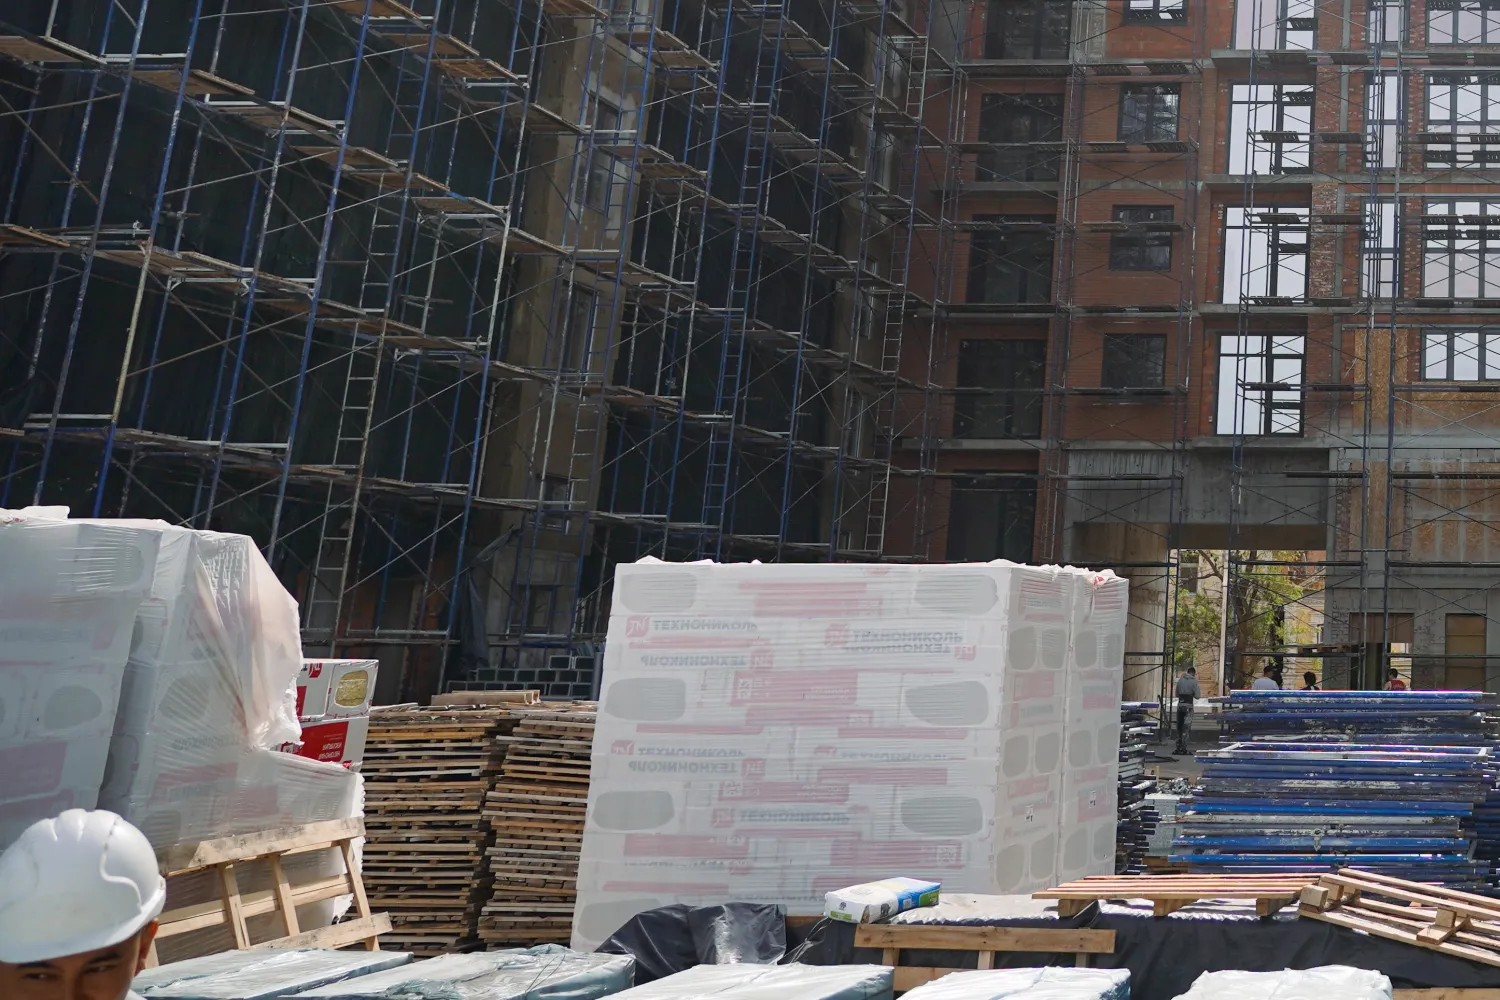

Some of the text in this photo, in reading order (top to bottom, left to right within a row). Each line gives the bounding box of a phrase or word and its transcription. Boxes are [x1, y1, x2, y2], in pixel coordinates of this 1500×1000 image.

[653, 619, 758, 631] ТЕХНОНИКОЛЬ
[853, 630, 964, 643] ТЕХНОНИКОЛЬ
[641, 655, 747, 667] ТЕХНОНИКОЛЬ
[627, 758, 737, 774] ТЕХНОНИКОЛЬ
